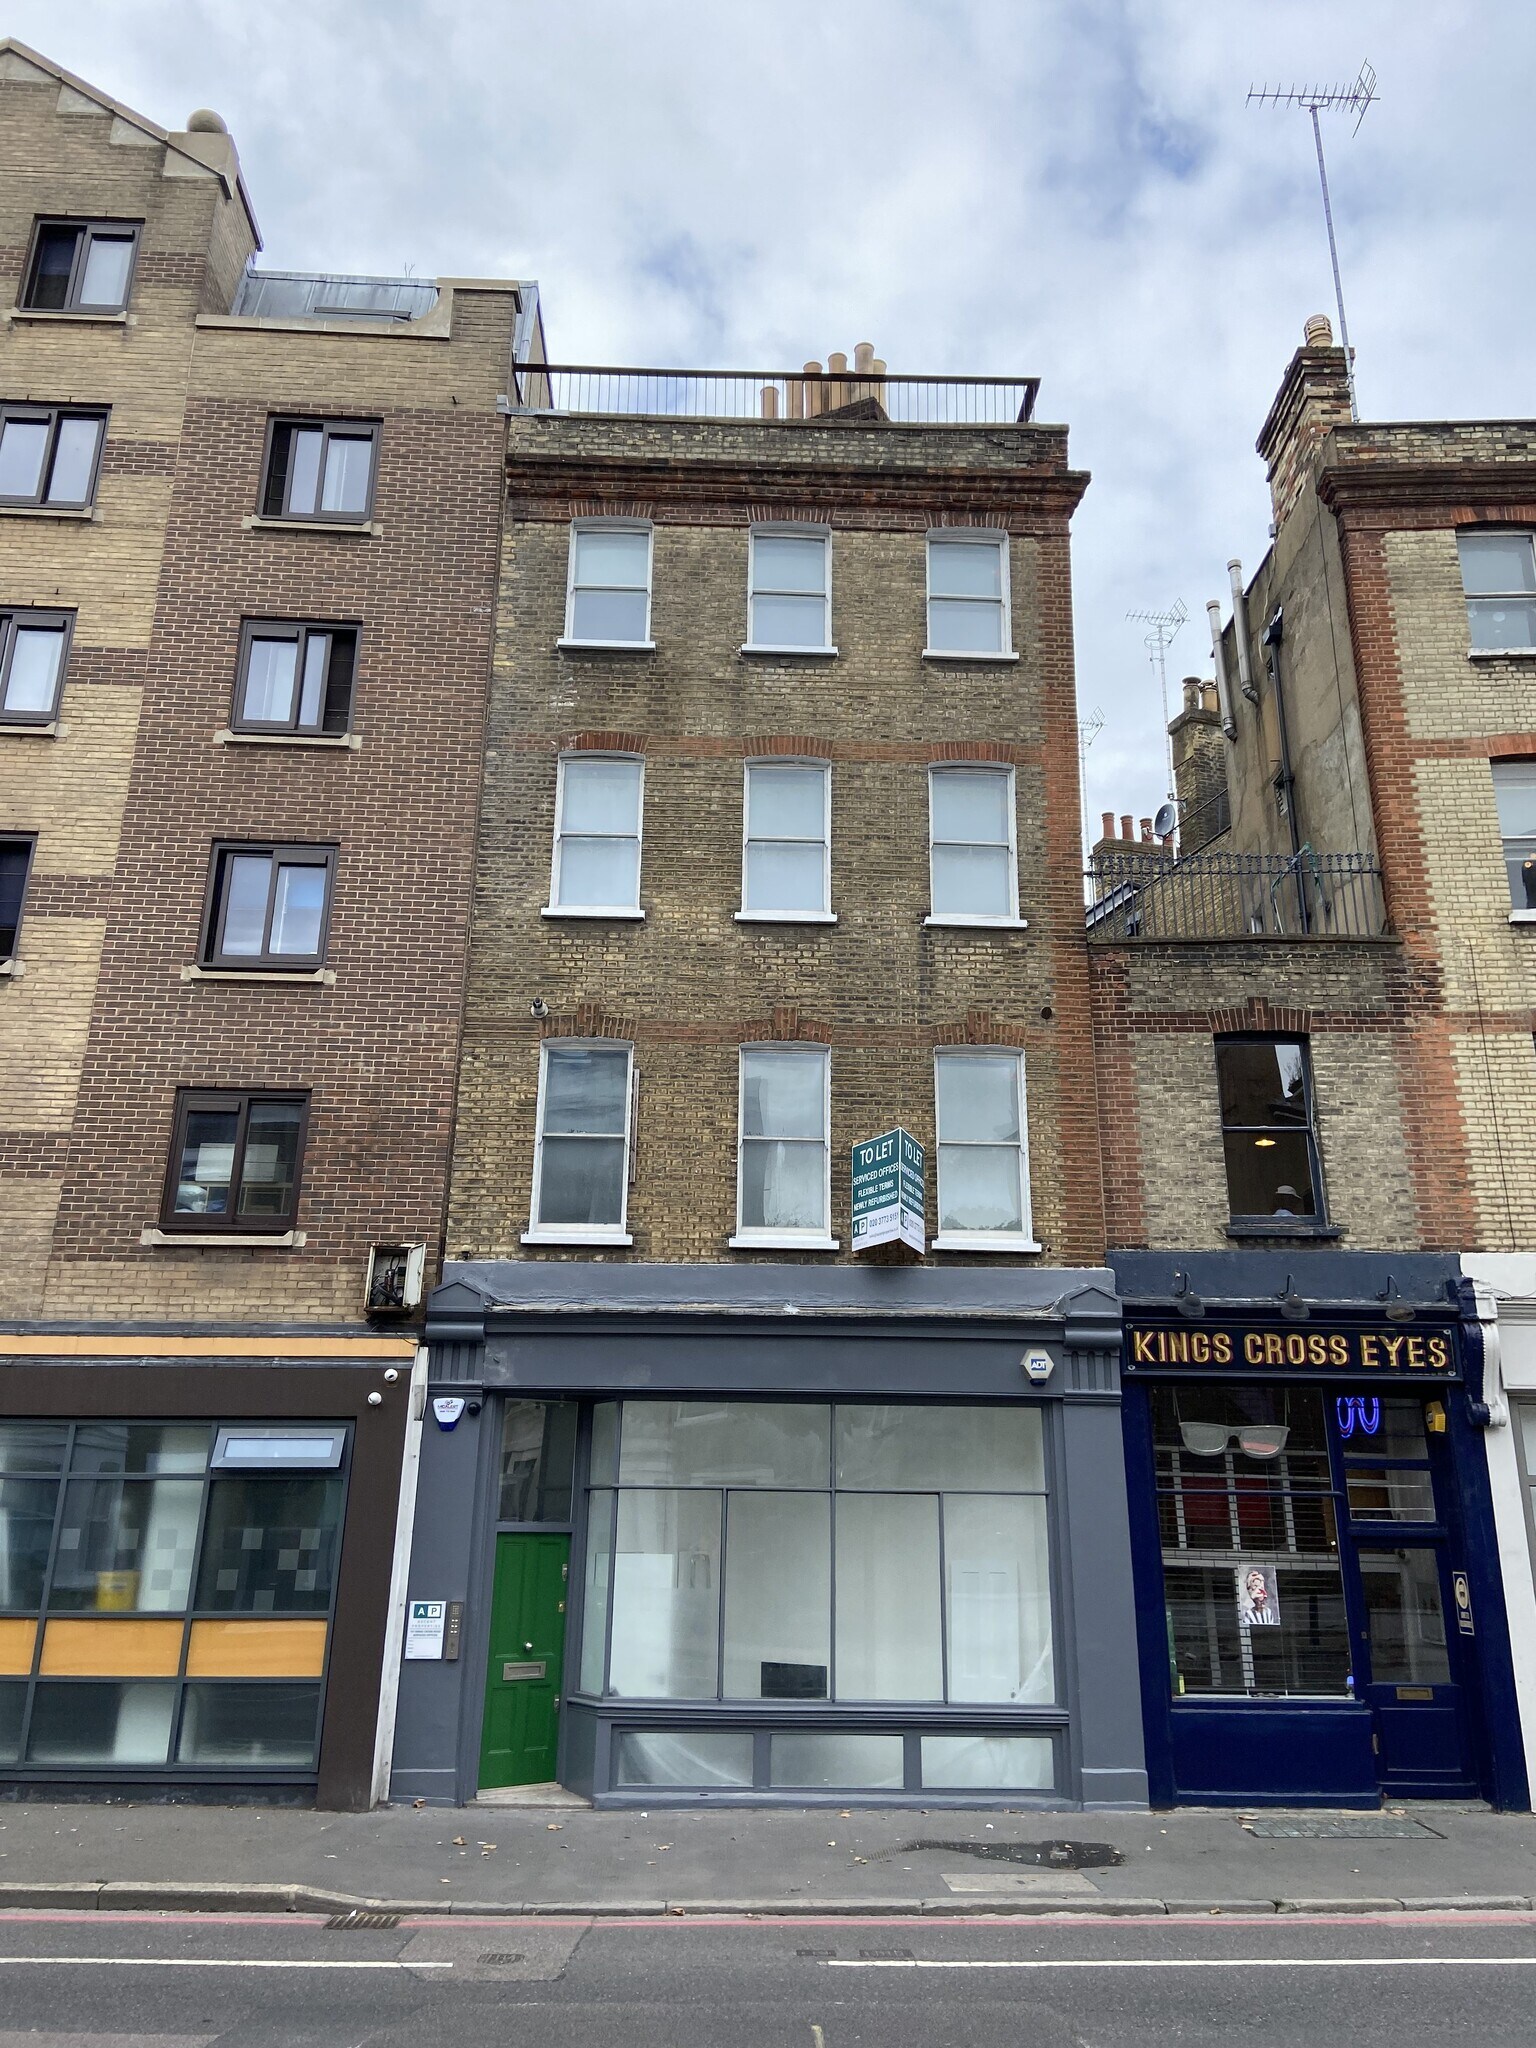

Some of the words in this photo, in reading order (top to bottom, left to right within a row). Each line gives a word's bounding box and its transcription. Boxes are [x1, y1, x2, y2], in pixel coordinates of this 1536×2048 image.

[860, 1147, 874, 1166] TO
[875, 1139, 894, 1161] LET
[904, 1139, 913, 1160] TO
[913, 1147, 923, 1168] LET
[853, 1170, 878, 1186] SERVICED
[878, 1162, 899, 1178] OFFICES
[857, 1184, 879, 1198] FLEXIBLE
[880, 1179, 894, 1191] TERMS
[853, 1200, 868, 1212] NEWLY
[868, 1190, 898, 1206] REFURBISHED
[869, 1218, 878, 1228] 020
[878, 1214, 889, 1225] 3773
[1133, 1331, 1233, 1364] KINGS
[1243, 1333, 1349, 1366] CROSS
[1360, 1335, 1449, 1368] EYES
[1031, 1361, 1047, 1369] ADT
